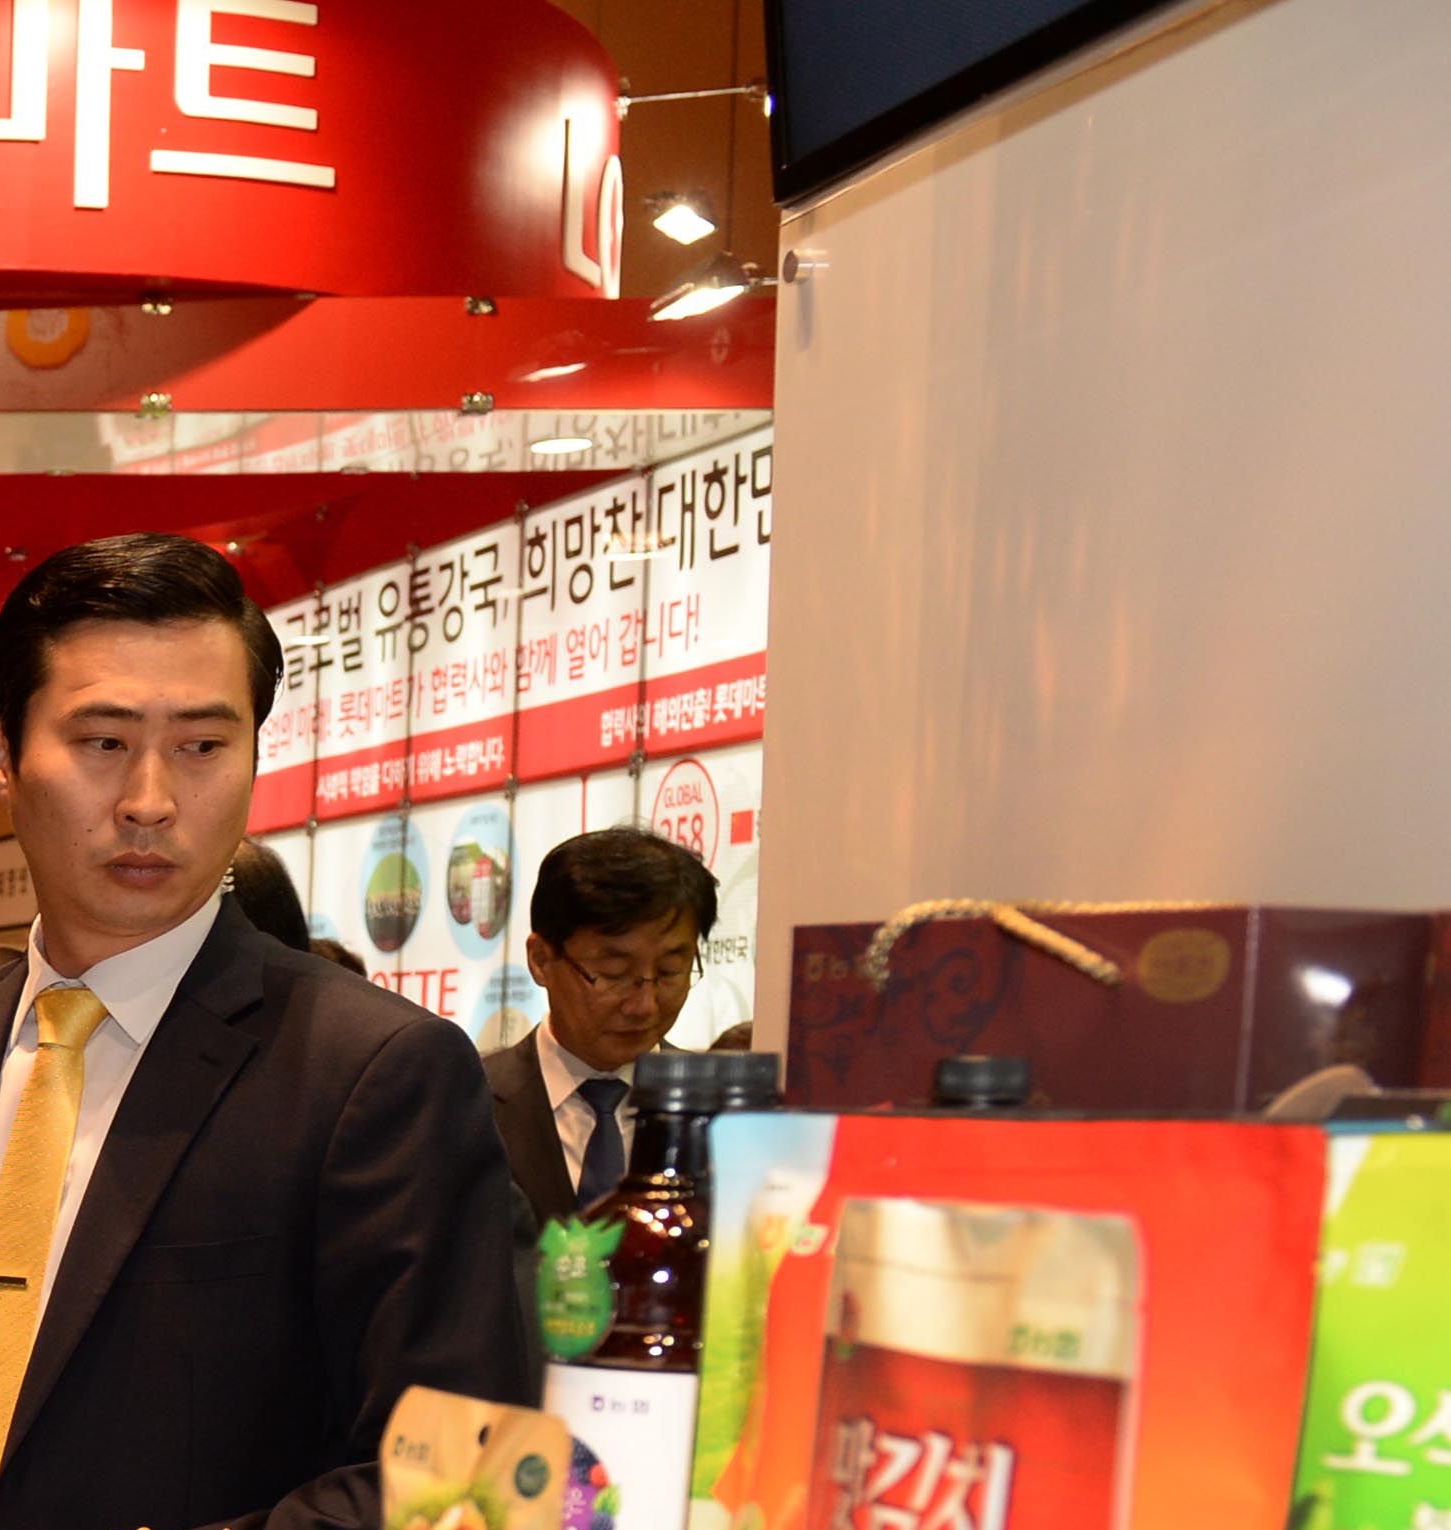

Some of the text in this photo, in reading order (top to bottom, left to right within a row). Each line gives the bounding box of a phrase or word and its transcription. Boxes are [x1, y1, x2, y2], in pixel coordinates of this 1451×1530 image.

[284, 590, 363, 691] 글로벌
[521, 490, 643, 612] 희망찬
[432, 648, 508, 716] 협력사와
[566, 618, 611, 680] 열어
[663, 780, 704, 809] GLOBAL
